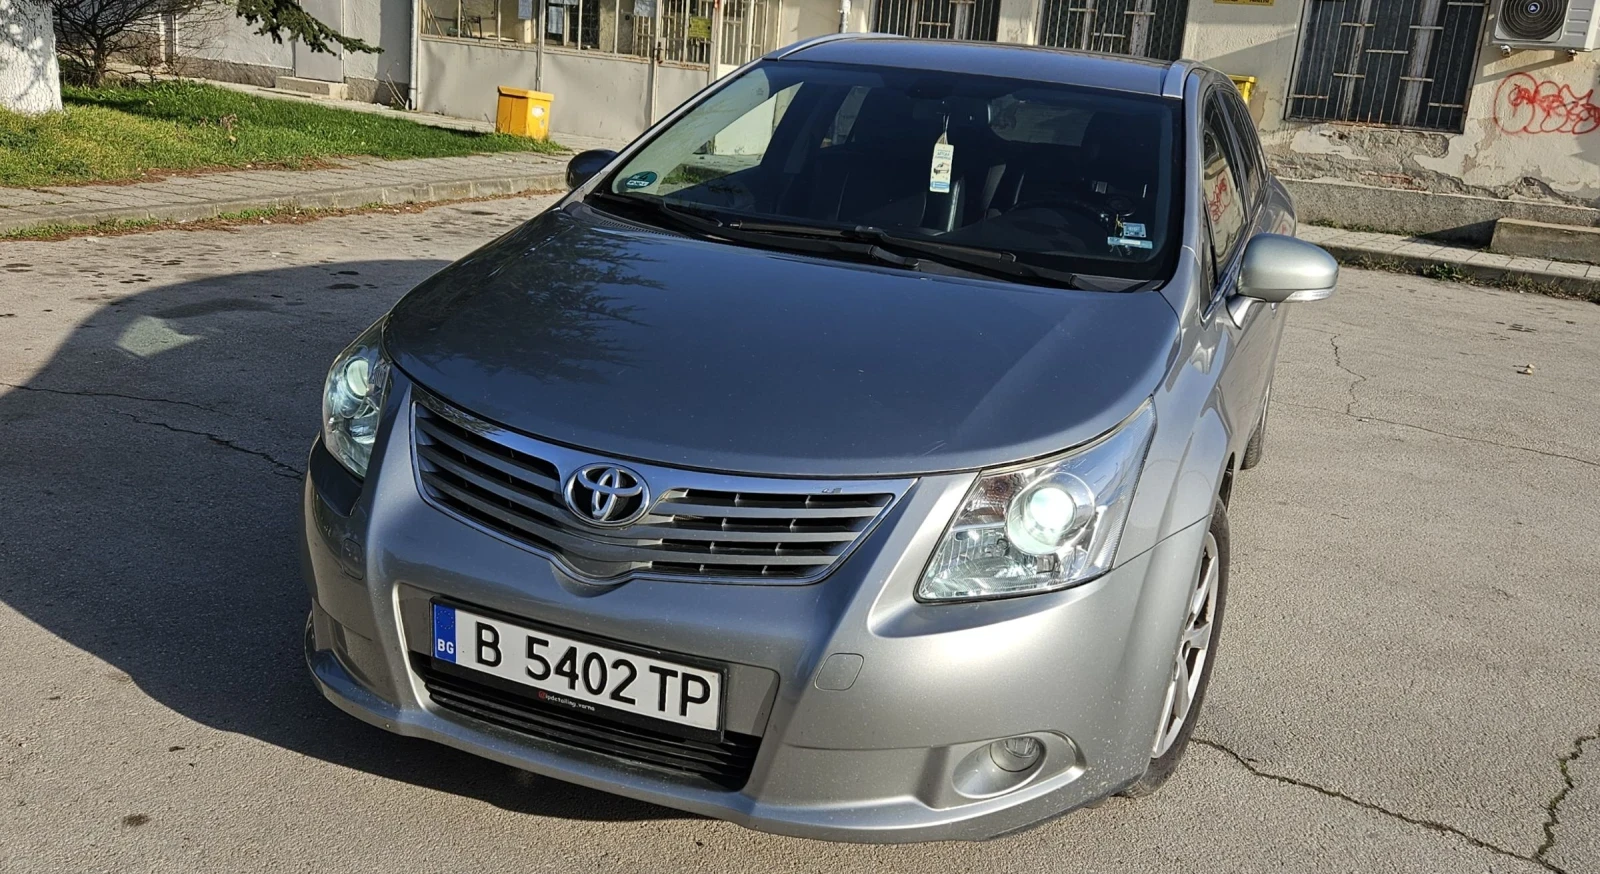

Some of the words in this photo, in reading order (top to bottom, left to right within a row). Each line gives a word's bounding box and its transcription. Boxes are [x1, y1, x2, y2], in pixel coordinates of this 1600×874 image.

[437, 638, 455, 655] BG
[475, 620, 502, 668] B
[525, 635, 637, 706] 5402
[649, 665, 711, 717] TP
